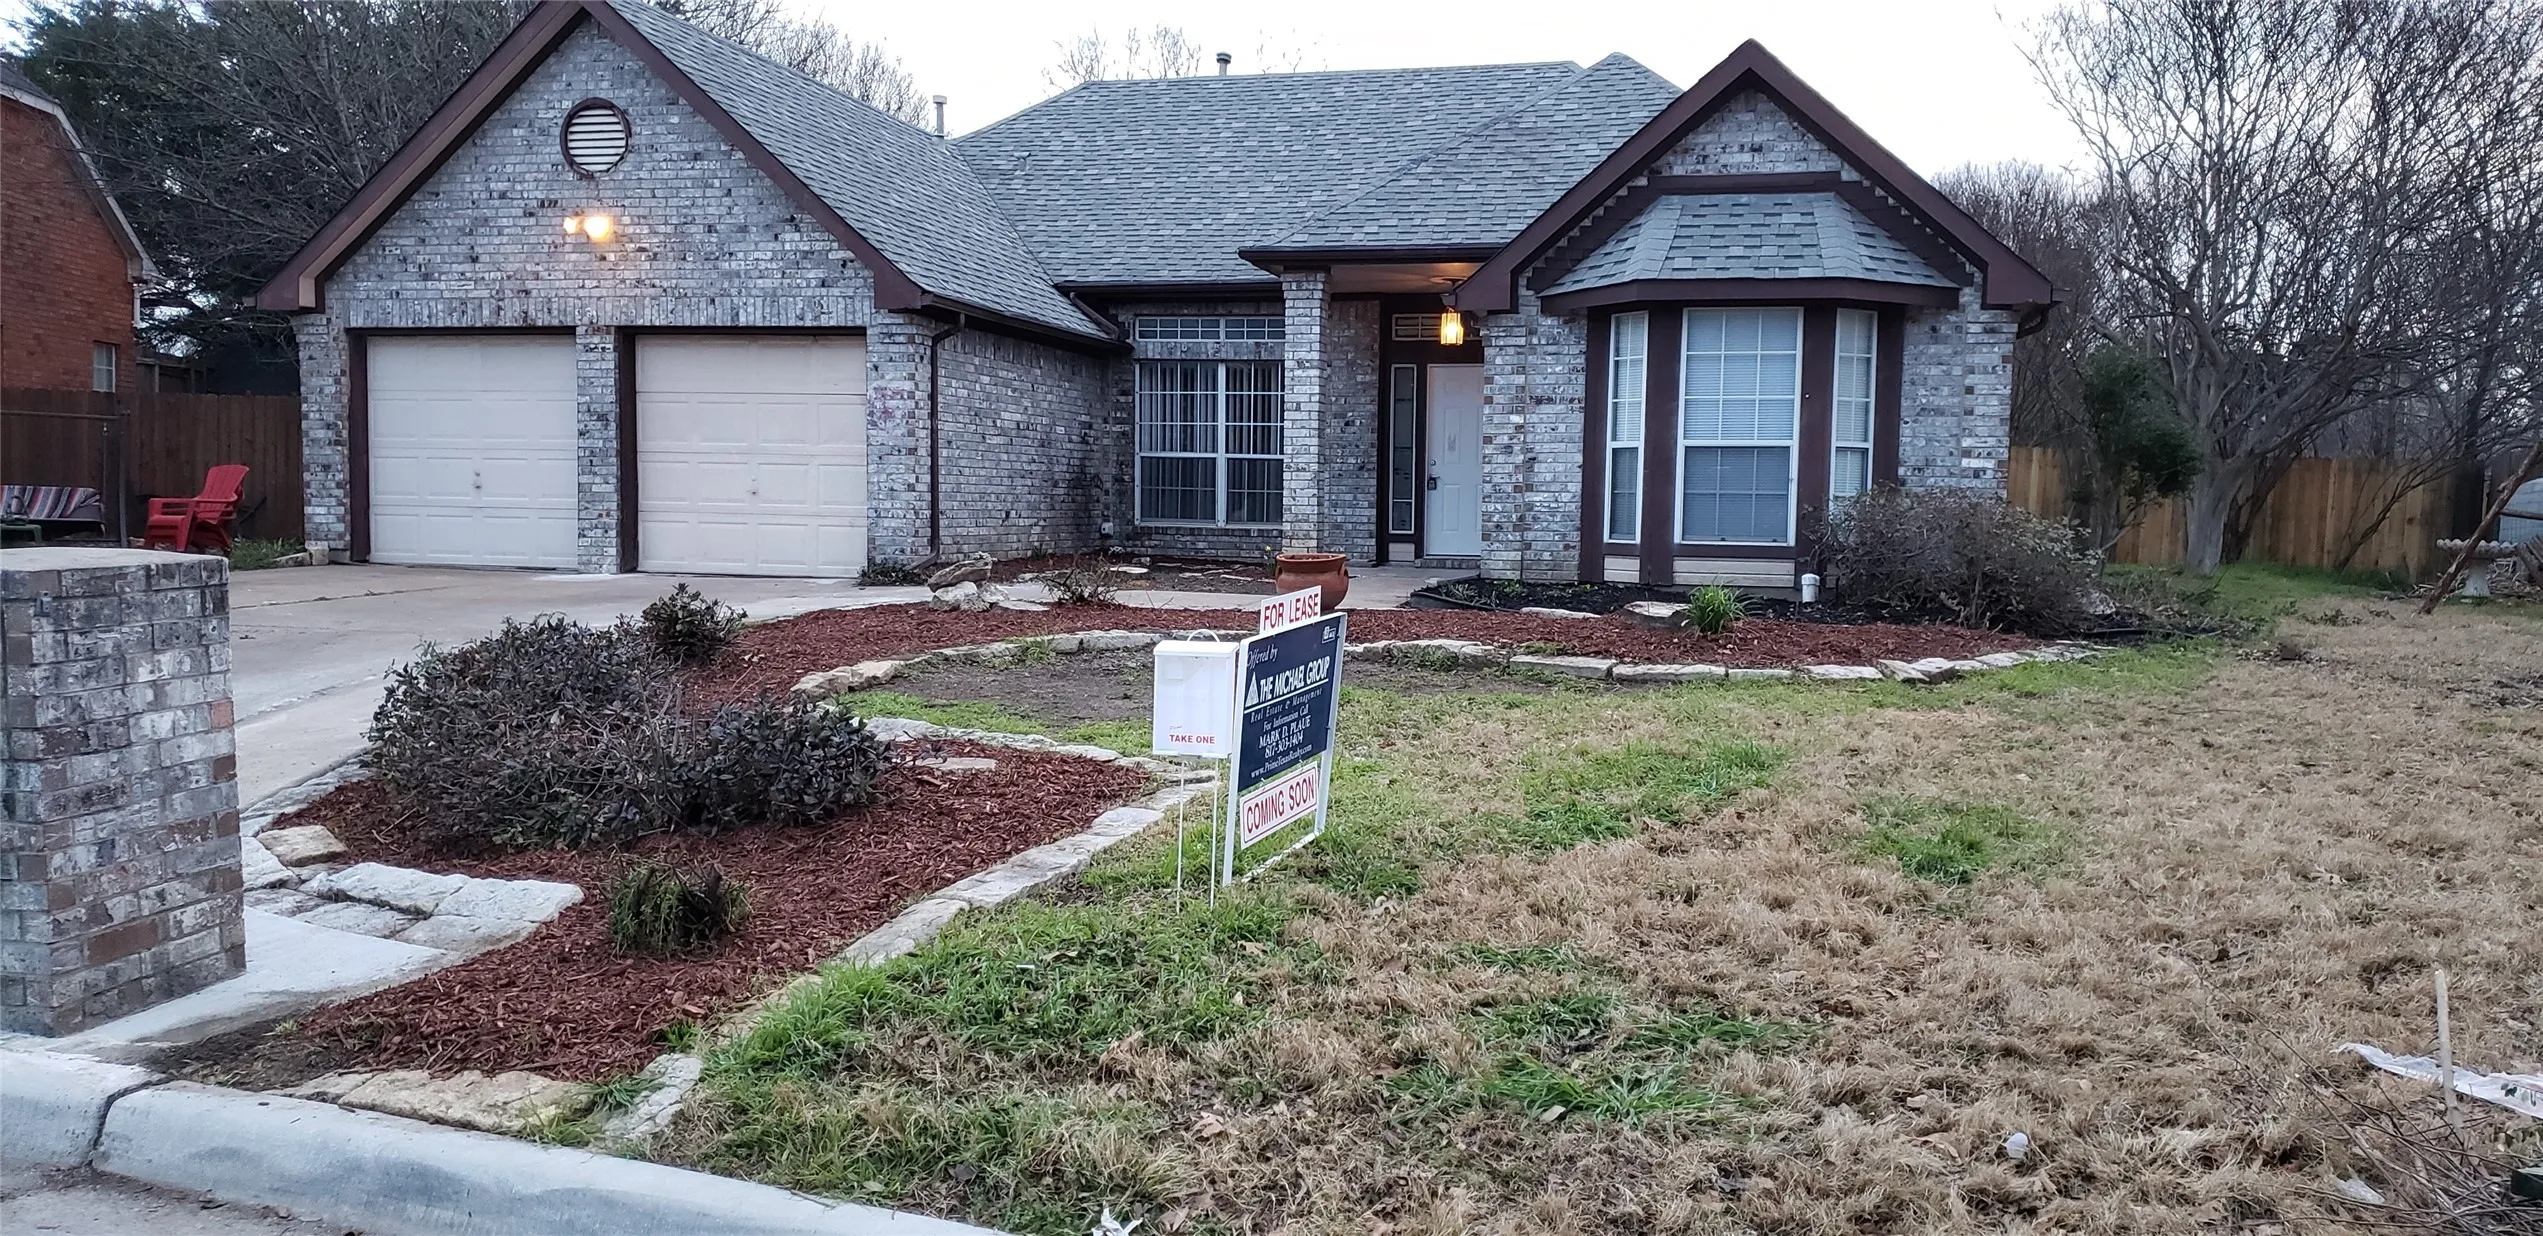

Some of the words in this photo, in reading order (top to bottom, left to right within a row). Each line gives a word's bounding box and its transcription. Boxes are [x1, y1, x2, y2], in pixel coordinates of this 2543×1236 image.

[1263, 602, 1285, 631] FOR
[1289, 593, 1319, 623] LEASE
[1247, 645, 1270, 669] Offered
[1270, 644, 1278, 662] by
[1260, 676, 1274, 702] THE
[1274, 665, 1305, 697] MICHAEL
[1306, 656, 1330, 684] GROUP
[1251, 709, 1263, 723] Real
[1266, 704, 1283, 716] Estate
[1285, 700, 1291, 710] &
[1292, 688, 1322, 706] Management
[1263, 720, 1272, 731] For
[1273, 710, 1298, 727] Information
[1300, 703, 1309, 716] Call
[1169, 734, 1193, 743] TAKE
[1196, 735, 1215, 744] ONE
[1259, 732, 1280, 748] MARK
[1281, 725, 1288, 738] D.
[1289, 715, 1311, 735] PLAUE
[1264, 731, 1304, 758] 817-303-1404
[1246, 790, 1285, 833] COMING
[1288, 774, 1315, 811] SOON
